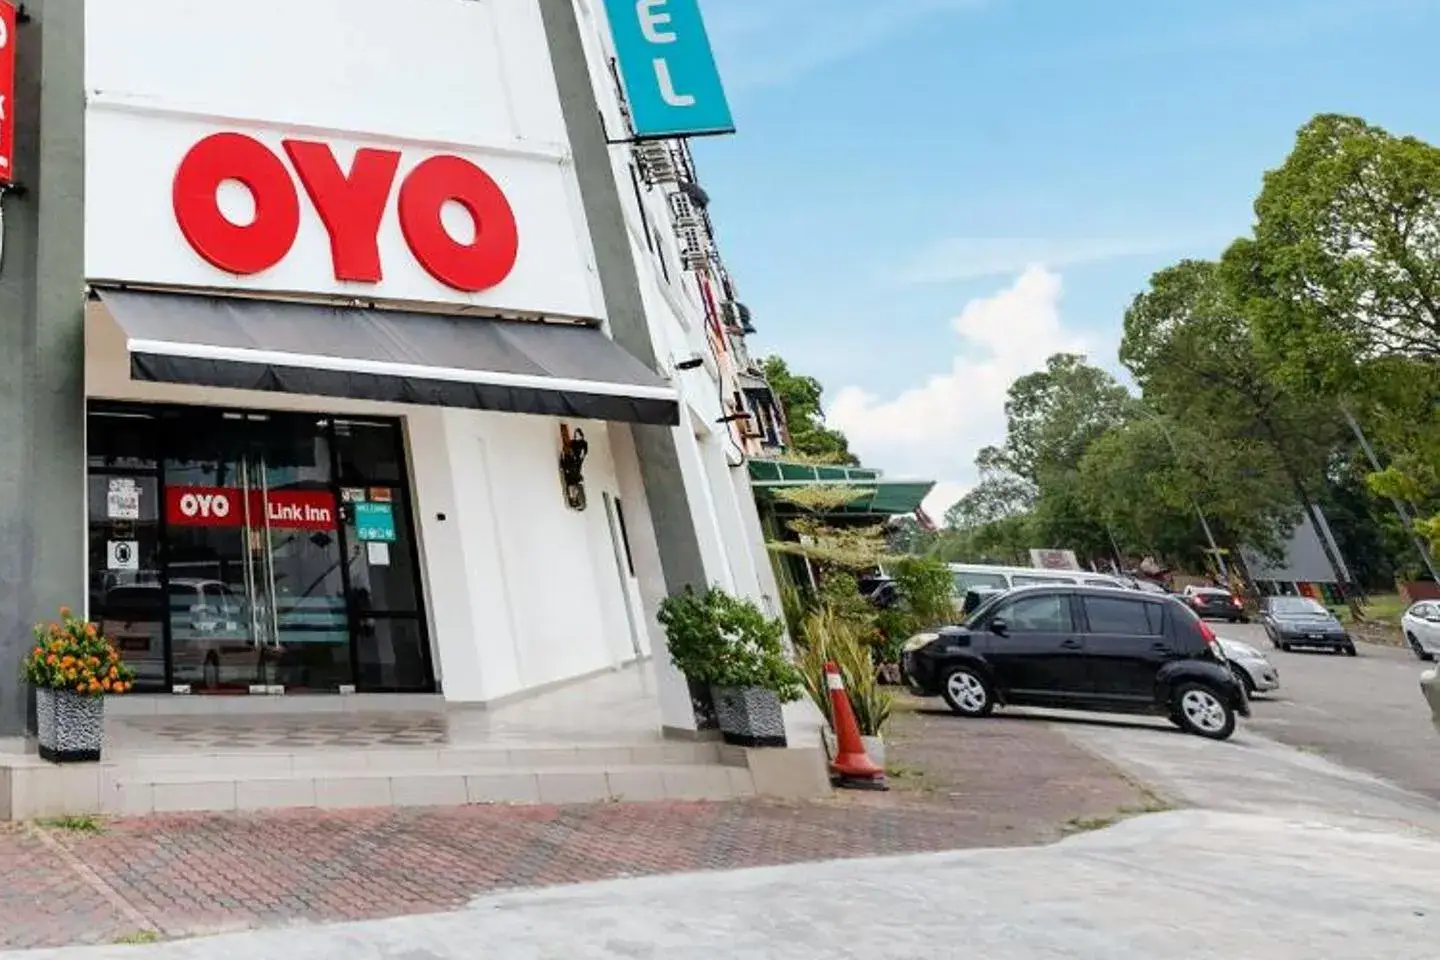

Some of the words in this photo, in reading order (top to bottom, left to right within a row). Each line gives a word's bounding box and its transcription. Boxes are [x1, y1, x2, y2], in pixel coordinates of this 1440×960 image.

[172, 131, 519, 292] OYO
[180, 493, 229, 518] OYO
[268, 502, 303, 521] Link
[305, 503, 331, 522] Inn
